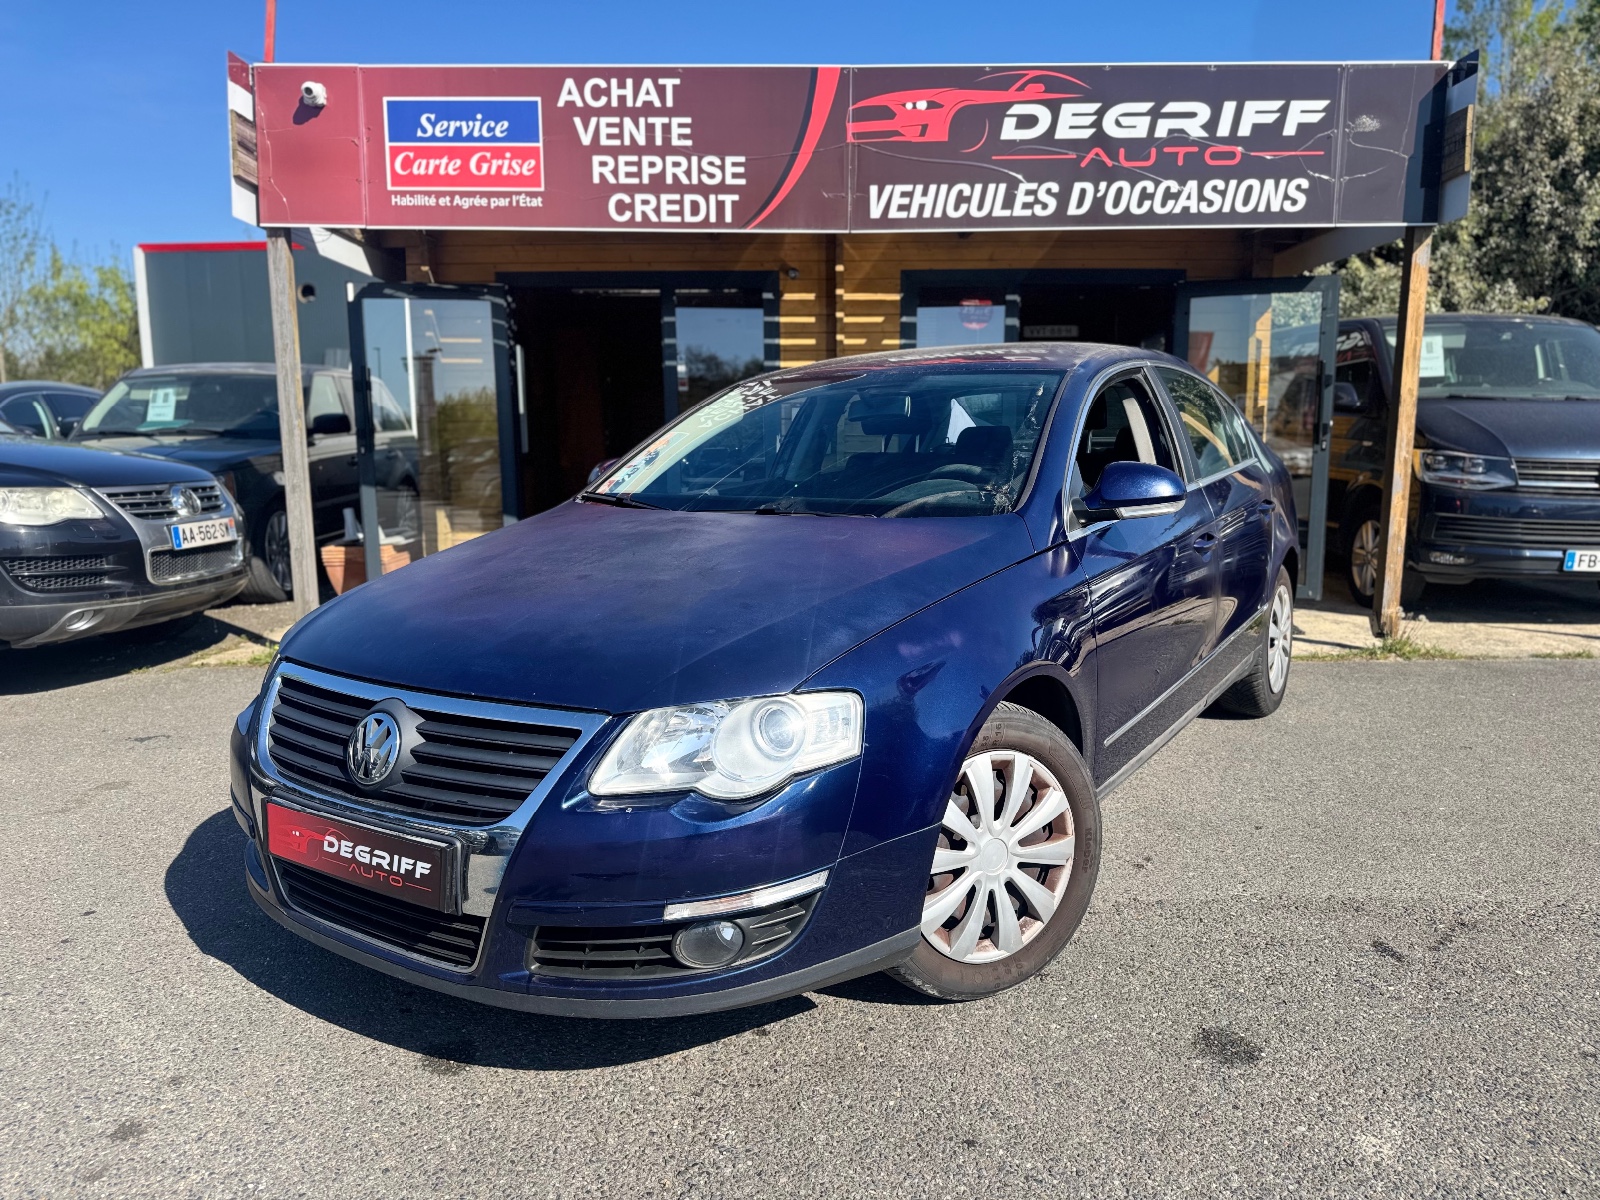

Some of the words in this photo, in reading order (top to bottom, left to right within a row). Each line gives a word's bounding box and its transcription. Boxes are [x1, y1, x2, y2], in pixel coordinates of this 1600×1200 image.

[556, 77, 681, 108] ACHAT
[416, 112, 510, 139] Service
[572, 116, 693, 147] VENTE
[999, 99, 1331, 141] DEGRIFF
[394, 151, 462, 177] Carte
[469, 151, 537, 178] Grise
[592, 154, 747, 186] REPRISE
[1080, 145, 1243, 169] AUTO
[391, 194, 436, 206] Habilité
[438, 195, 451, 206] et
[453, 194, 488, 209] Agrée
[490, 196, 510, 209] par
[607, 192, 740, 223] CREDIT
[868, 181, 1058, 220] VEHICULES
[323, 835, 432, 879] DEGRIFF
[348, 863, 403, 887] AUTO
